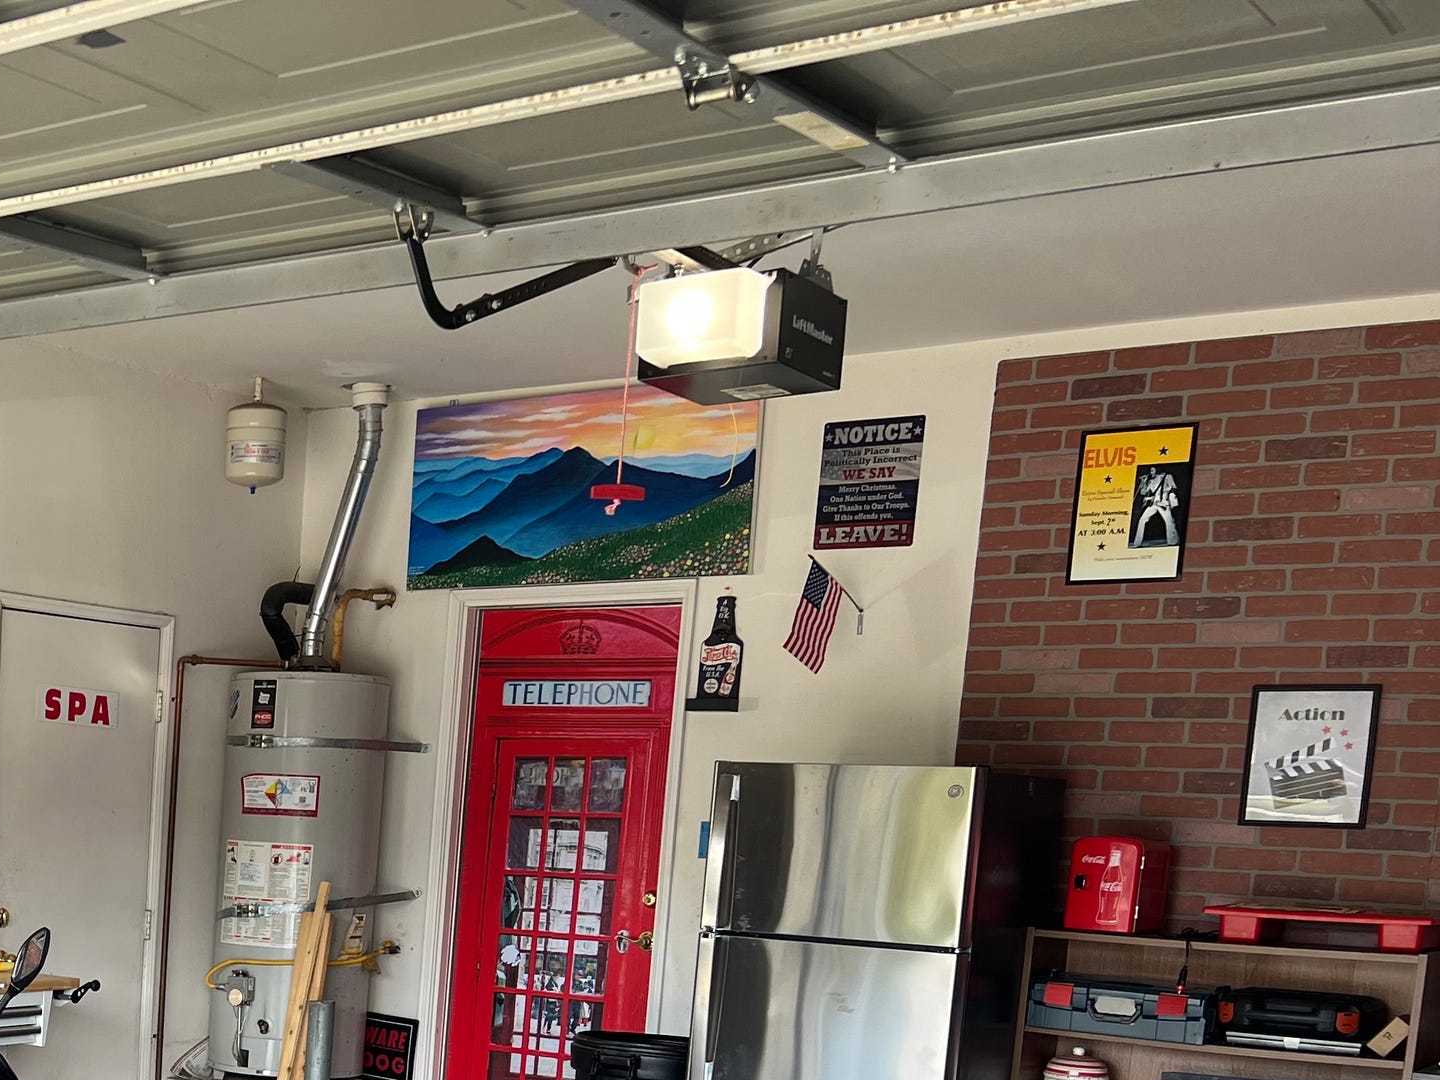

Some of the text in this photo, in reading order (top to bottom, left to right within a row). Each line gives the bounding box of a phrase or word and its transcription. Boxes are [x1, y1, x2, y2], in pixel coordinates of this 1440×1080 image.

[792, 314, 833, 345] LiftMaster
[834, 422, 913, 445] NOTICE
[824, 454, 917, 467] Politically Incorrect
[842, 446, 901, 458] This Place is
[1083, 446, 1136, 469] ELVIS
[843, 466, 896, 480] WE SAY
[838, 486, 860, 494] Merry
[838, 504, 862, 512] Thanks
[841, 513, 853, 521] this
[854, 512, 878, 520] offends
[818, 524, 908, 544] LEAVE!
[509, 682, 646, 705] TELEPHONE
[45, 688, 110, 726] SPA
[1278, 707, 1345, 721] Action
[1082, 855, 1106, 865] Coca-Cola
[366, 1027, 408, 1050] WARE
[363, 1051, 405, 1074] DOG
